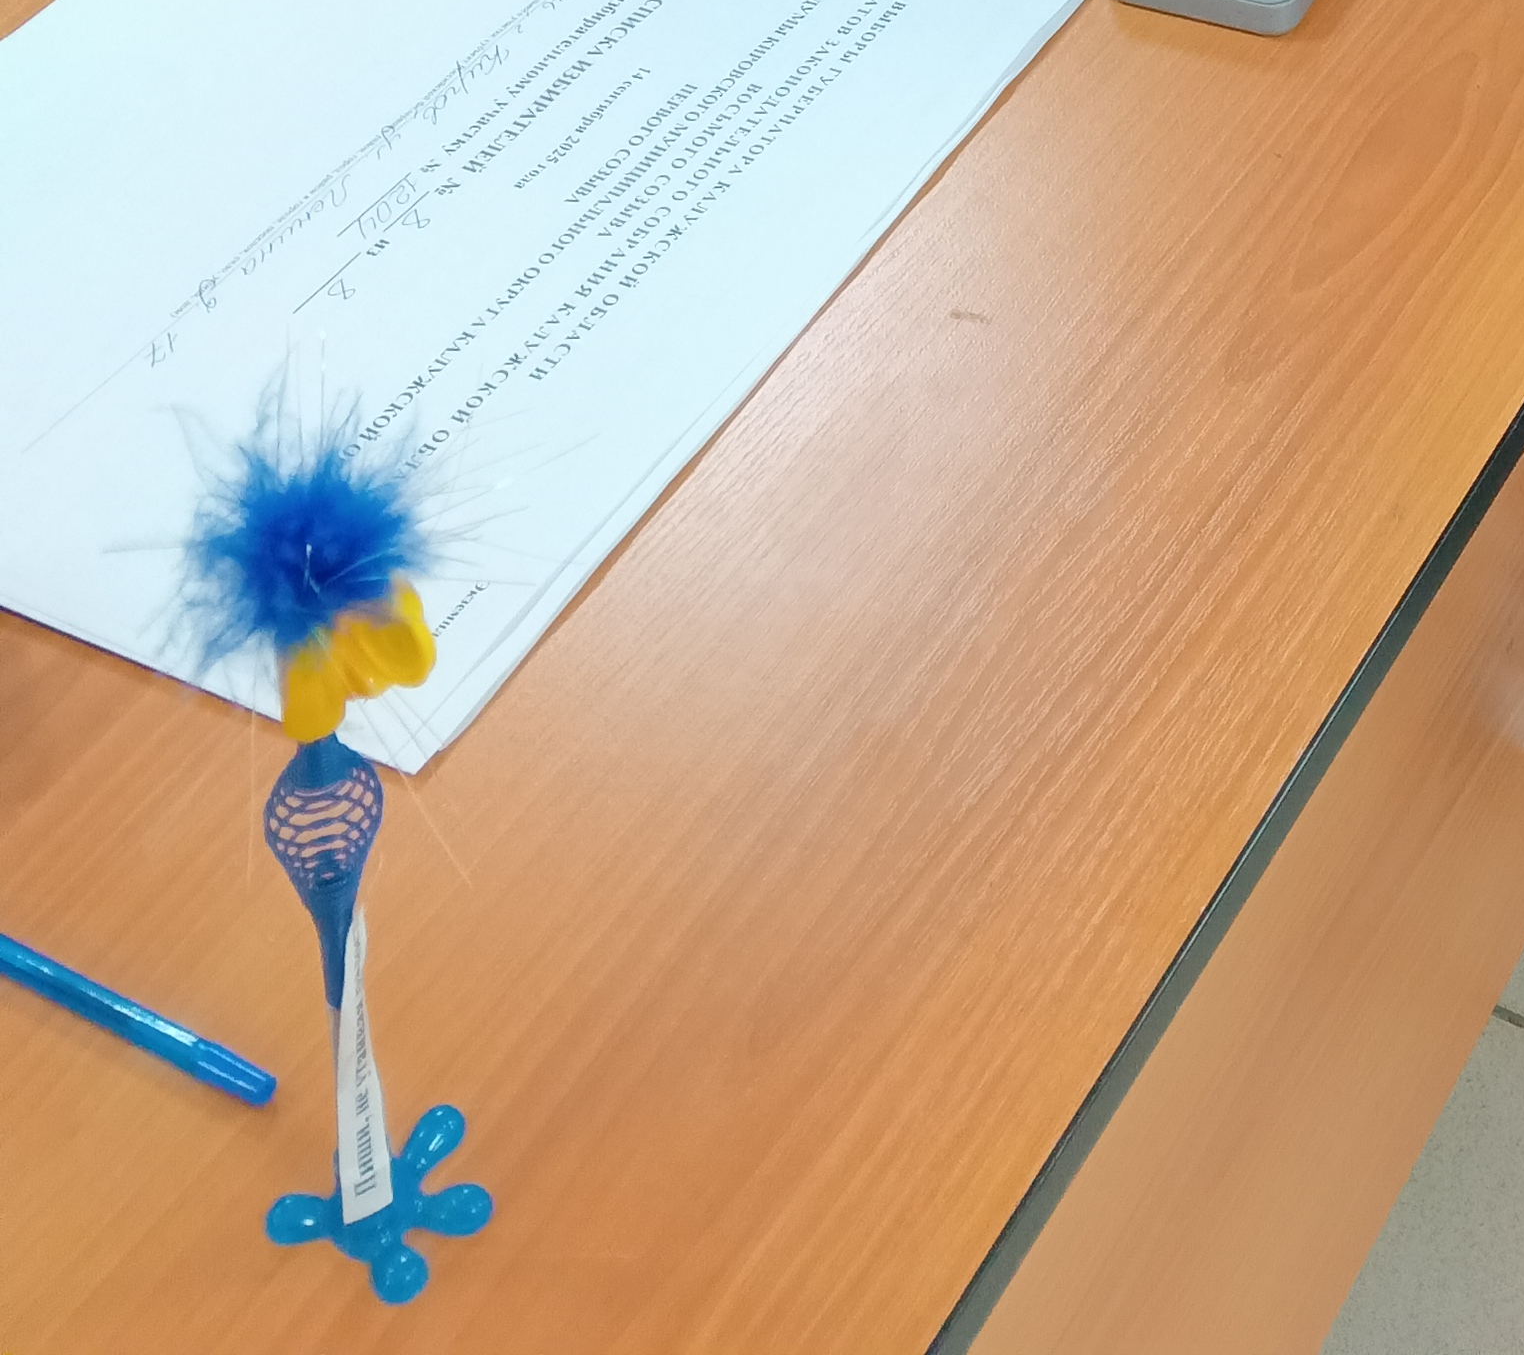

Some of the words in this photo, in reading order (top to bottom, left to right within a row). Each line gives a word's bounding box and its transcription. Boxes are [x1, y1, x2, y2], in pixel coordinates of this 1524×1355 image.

[838, 0, 907, 64] ВЫБОРЫ
[630, 66, 651, 80] 14
[683, 35, 780, 122] КИРОВСКОГО
[440, 97, 509, 156] участку
[460, 58, 593, 173] ИЗБИРАТЕЛЕЙ
[573, 80, 633, 134] сентября
[627, 82, 698, 147] ПЕРВОГО
[670, 39, 840, 201] ЗАКОНОДАТЕЛЬНОГО
[670, 82, 763, 169] ВОСЬМОГО
[726, 66, 843, 174] ГУБЕРНАТОРА
[512, 162, 547, 189] года
[544, 134, 581, 164] 2025
[562, 147, 631, 203] СОЗЫВА
[433, 176, 461, 196] №
[537, 121, 689, 265] МУНИЦИПАЛЬНОГО
[596, 173, 671, 237] СОЗЫВА
[365, 237, 390, 257] из
[399, 207, 431, 230] 8
[617, 179, 731, 288] КАЛУЖСКОЙ
[573, 205, 672, 298] СОБРАНИЯ
[326, 277, 357, 301] 8
[470, 266, 541, 327] ОКРУГА
[449, 301, 576, 424] КАЛУЖСКОЙ
[527, 292, 619, 381] ОБЛАСТИ
[357, 330, 476, 442] КАЛУЖСКОЙ
[385, 428, 450, 486] ОБЛА
